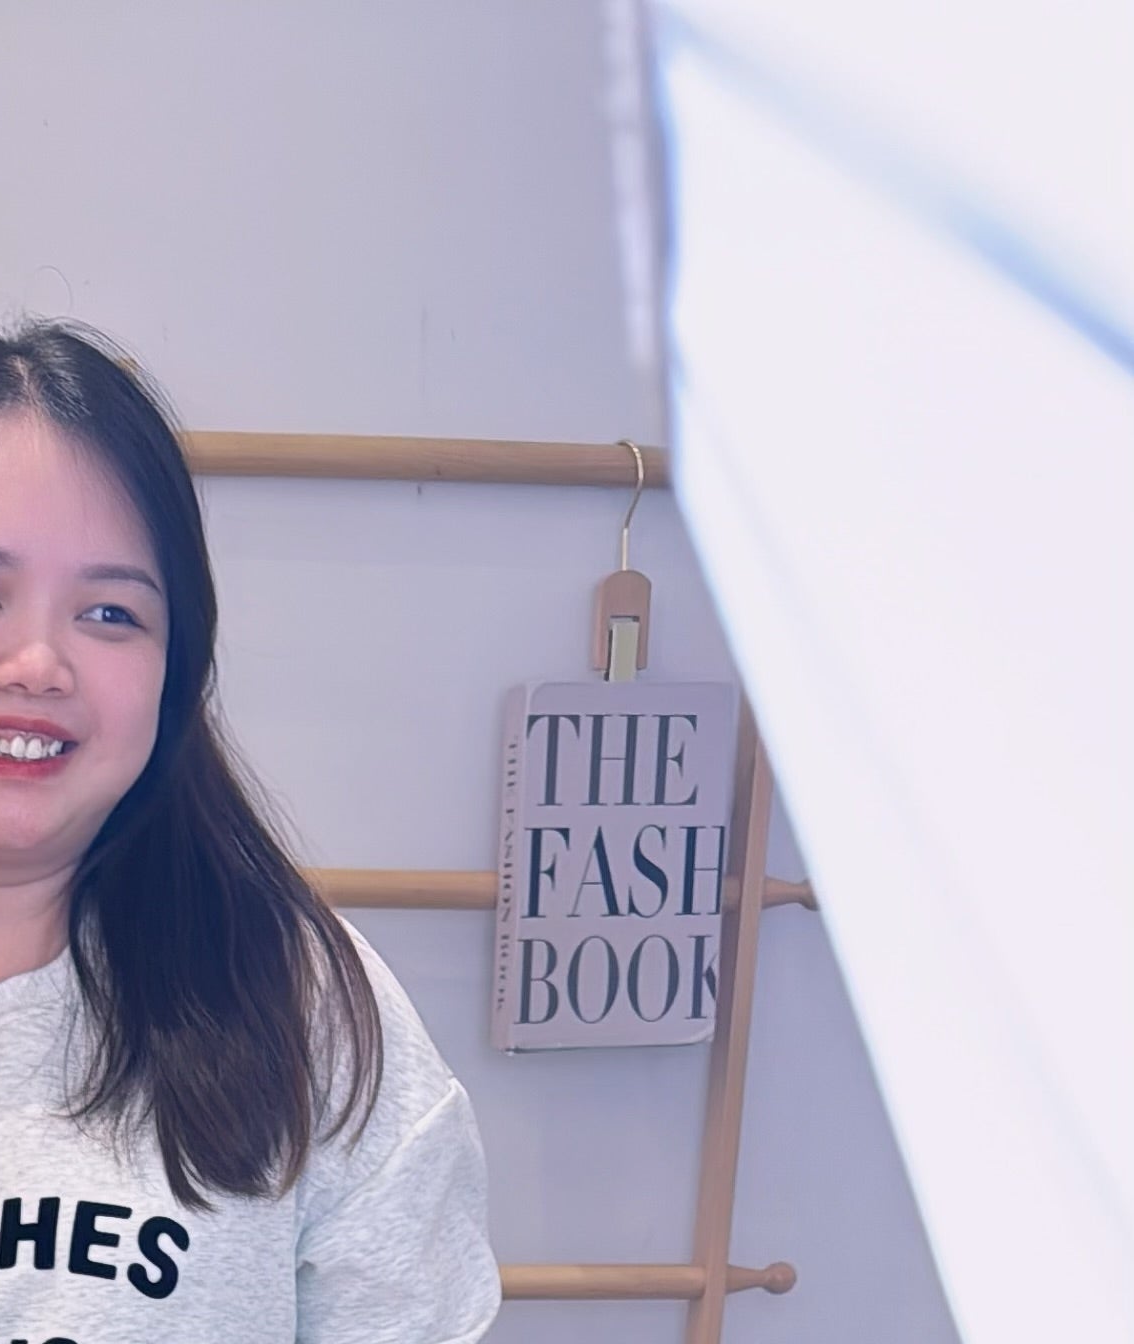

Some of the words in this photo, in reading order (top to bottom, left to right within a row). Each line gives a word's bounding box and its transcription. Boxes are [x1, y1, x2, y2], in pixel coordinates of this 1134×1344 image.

[526, 714, 698, 807] THE
[520, 824, 726, 919] FASH
[514, 935, 717, 1025] BOOK
